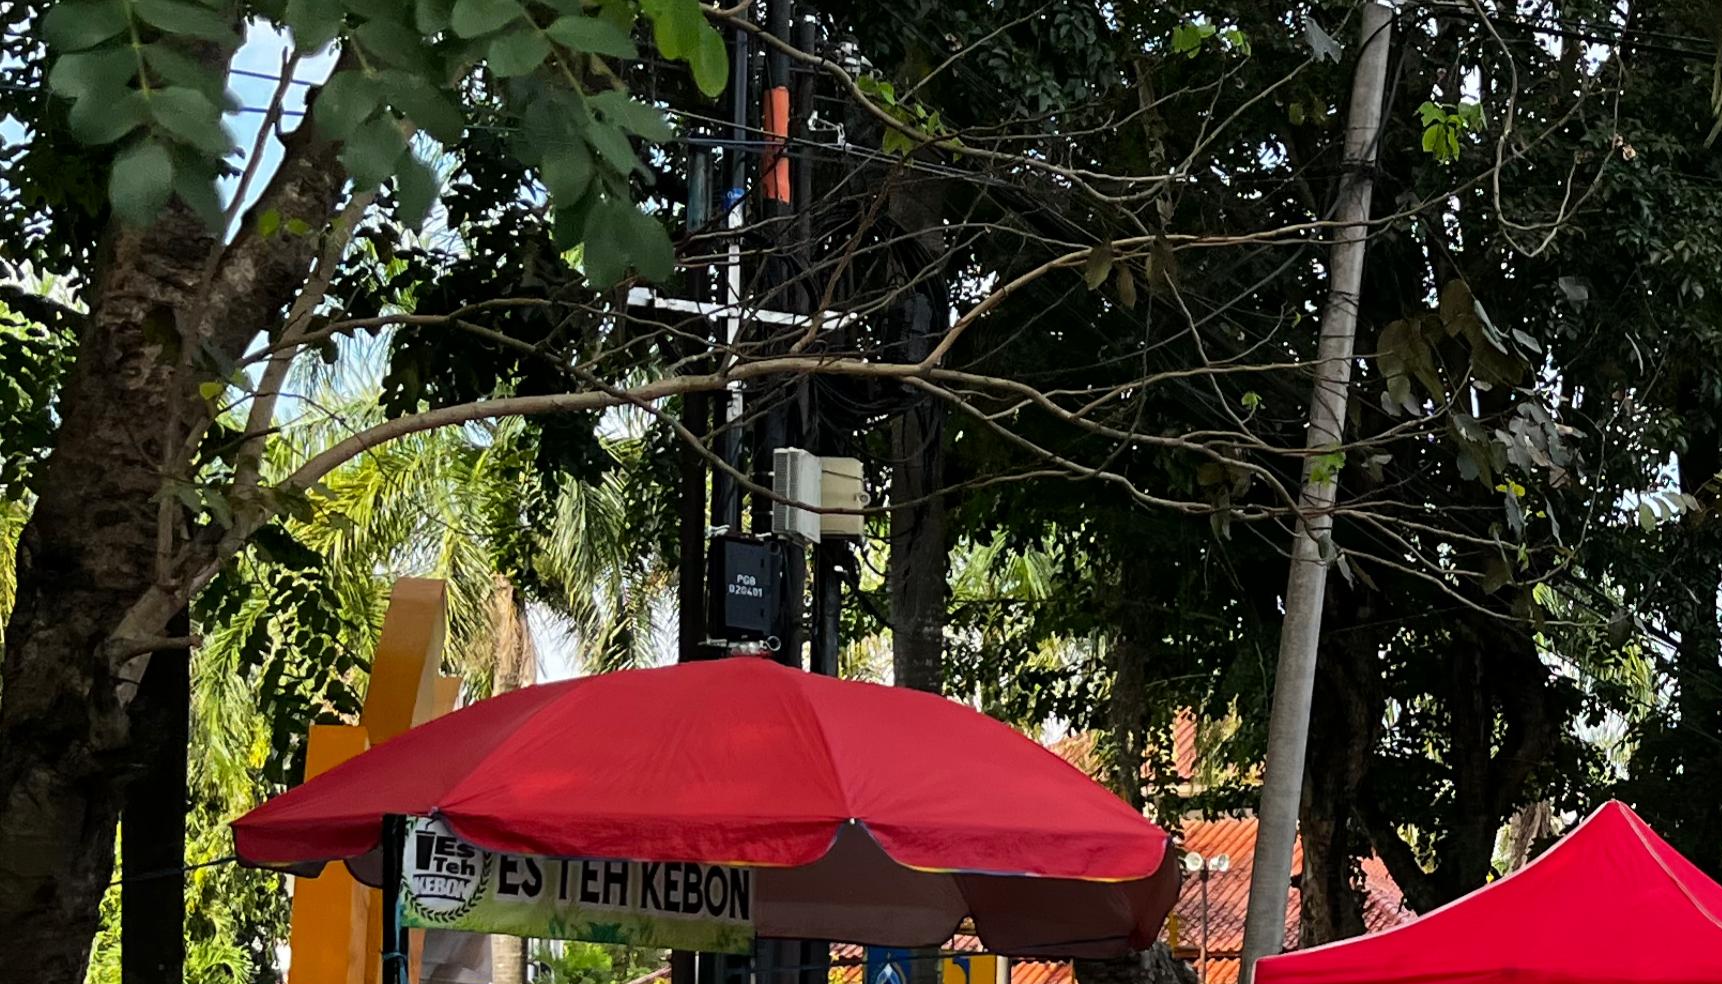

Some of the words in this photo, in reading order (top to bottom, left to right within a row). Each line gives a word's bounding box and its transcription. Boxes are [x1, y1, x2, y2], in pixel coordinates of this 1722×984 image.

[433, 856, 476, 877] Teh
[497, 855, 543, 897] ES
[640, 861, 750, 921] KEBON
